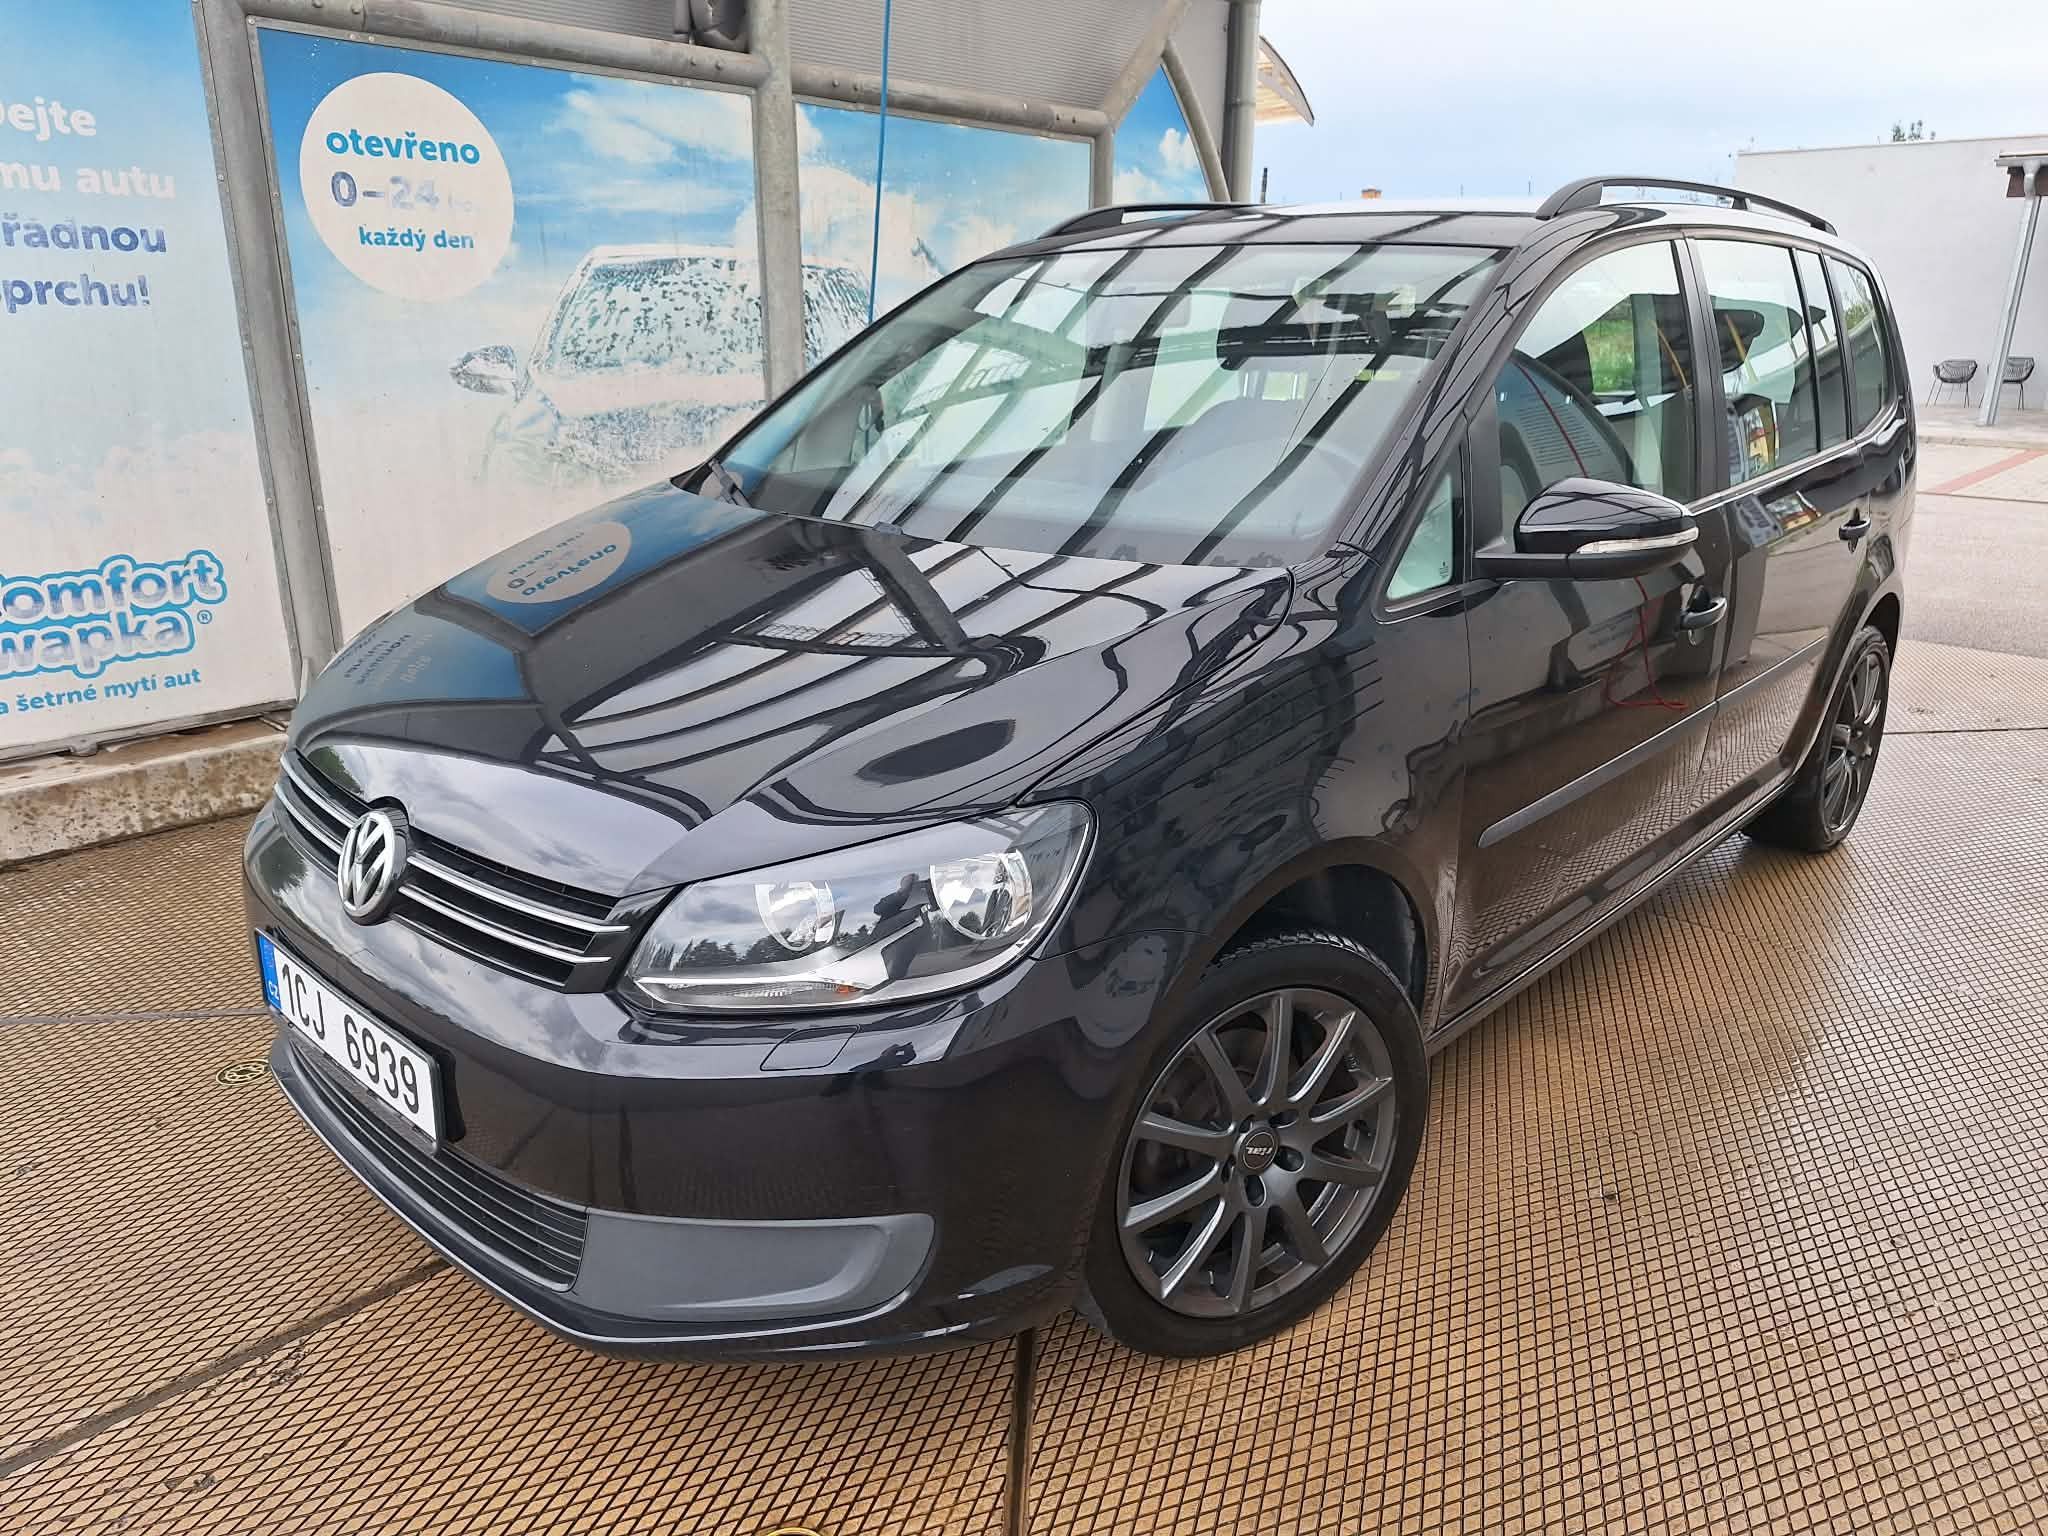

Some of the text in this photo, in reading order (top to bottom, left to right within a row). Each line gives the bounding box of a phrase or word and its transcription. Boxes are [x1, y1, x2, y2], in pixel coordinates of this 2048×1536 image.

[0, 96, 97, 141] ejte
[326, 128, 480, 165] otevřeno
[76, 166, 177, 199] autu
[359, 224, 475, 252] každý den
[0, 273, 150, 313] prchu!
[0, 558, 217, 619] omfort
[16, 684, 97, 713] šetrné
[104, 674, 158, 698] mytí
[164, 668, 202, 689] aut
[282, 963, 419, 1115] 1CJ 6939
